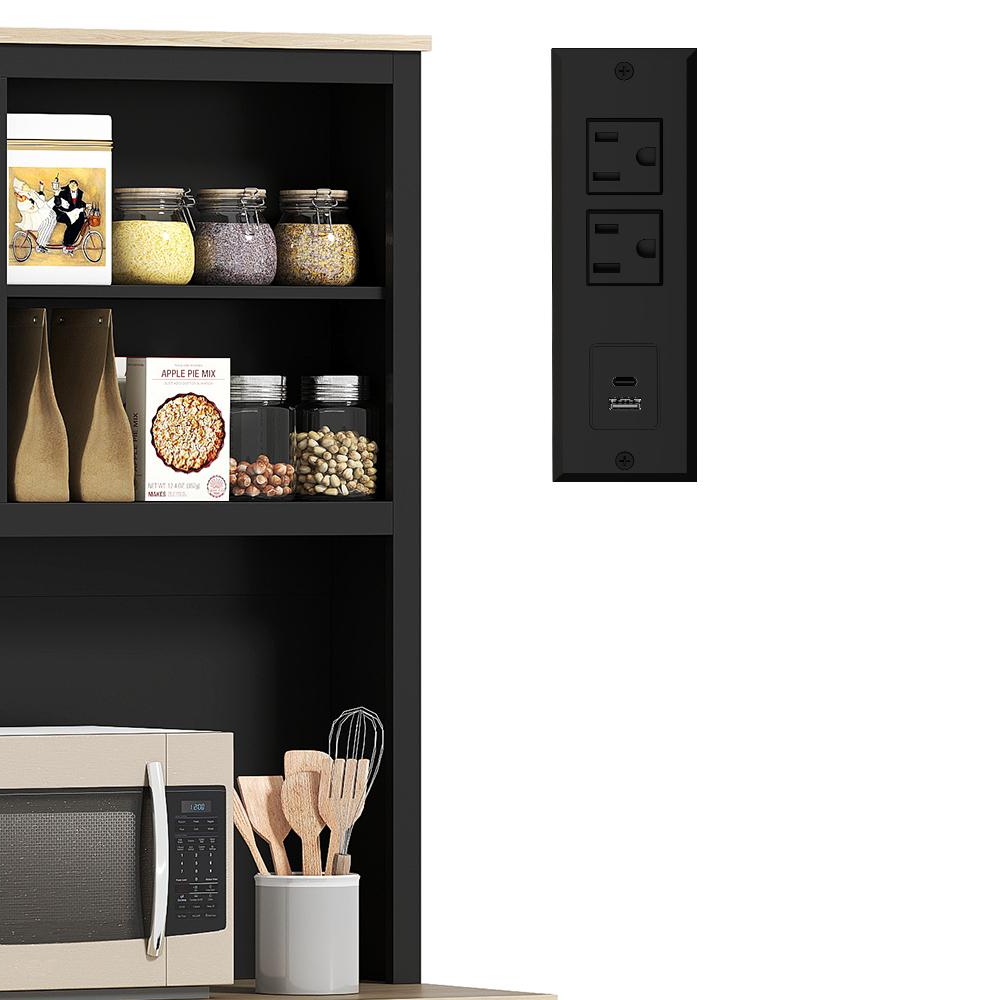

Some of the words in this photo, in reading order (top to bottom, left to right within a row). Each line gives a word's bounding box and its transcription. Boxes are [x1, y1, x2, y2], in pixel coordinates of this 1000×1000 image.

[161, 369, 186, 378] APPLE
[187, 369, 200, 378] PIE
[201, 369, 216, 378] MIX
